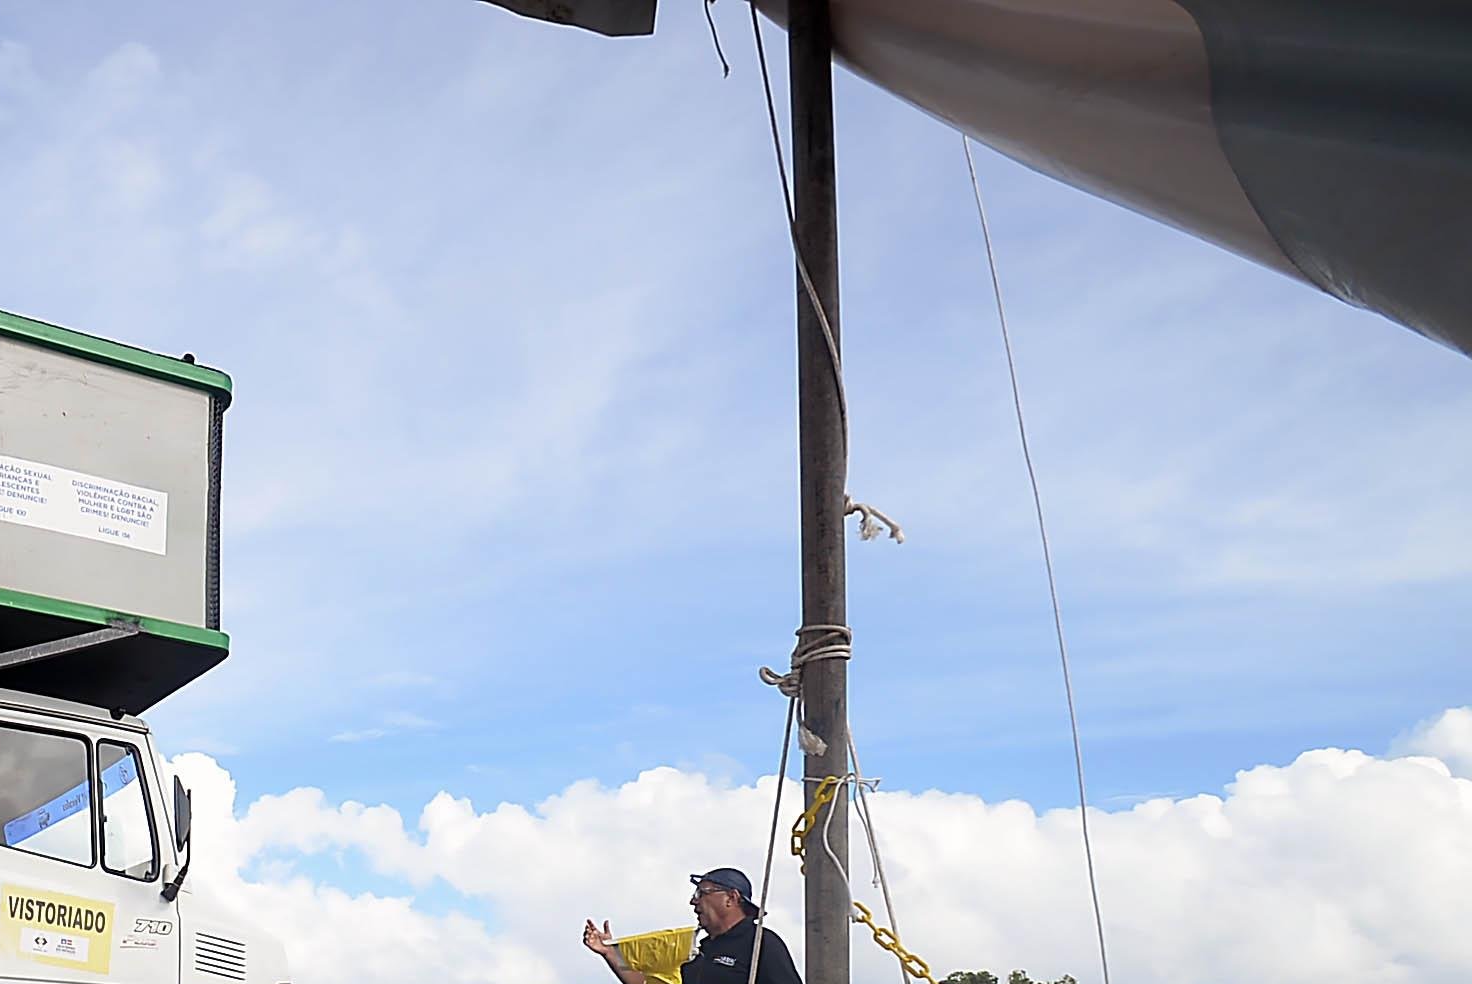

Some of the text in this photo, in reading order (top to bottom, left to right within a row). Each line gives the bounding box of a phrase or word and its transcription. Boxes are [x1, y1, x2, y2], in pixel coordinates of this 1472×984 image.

[23, 468, 53, 481] SEXUAL
[6, 490, 48, 504] DENUNCIE!
[71, 479, 130, 499] DISCRIMINAÇÃO
[76, 488, 115, 503] VIOLÊNCIA
[117, 498, 147, 511] CONTRA
[78, 497, 108, 509] MULHER
[116, 506, 135, 516] LGBT
[136, 510, 152, 520] SÃO
[80, 506, 109, 518] CRIMES!
[98, 525, 120, 537] LIGUE
[8, 895, 106, 934] VISTORIADO
[134, 918, 173, 936] 710
